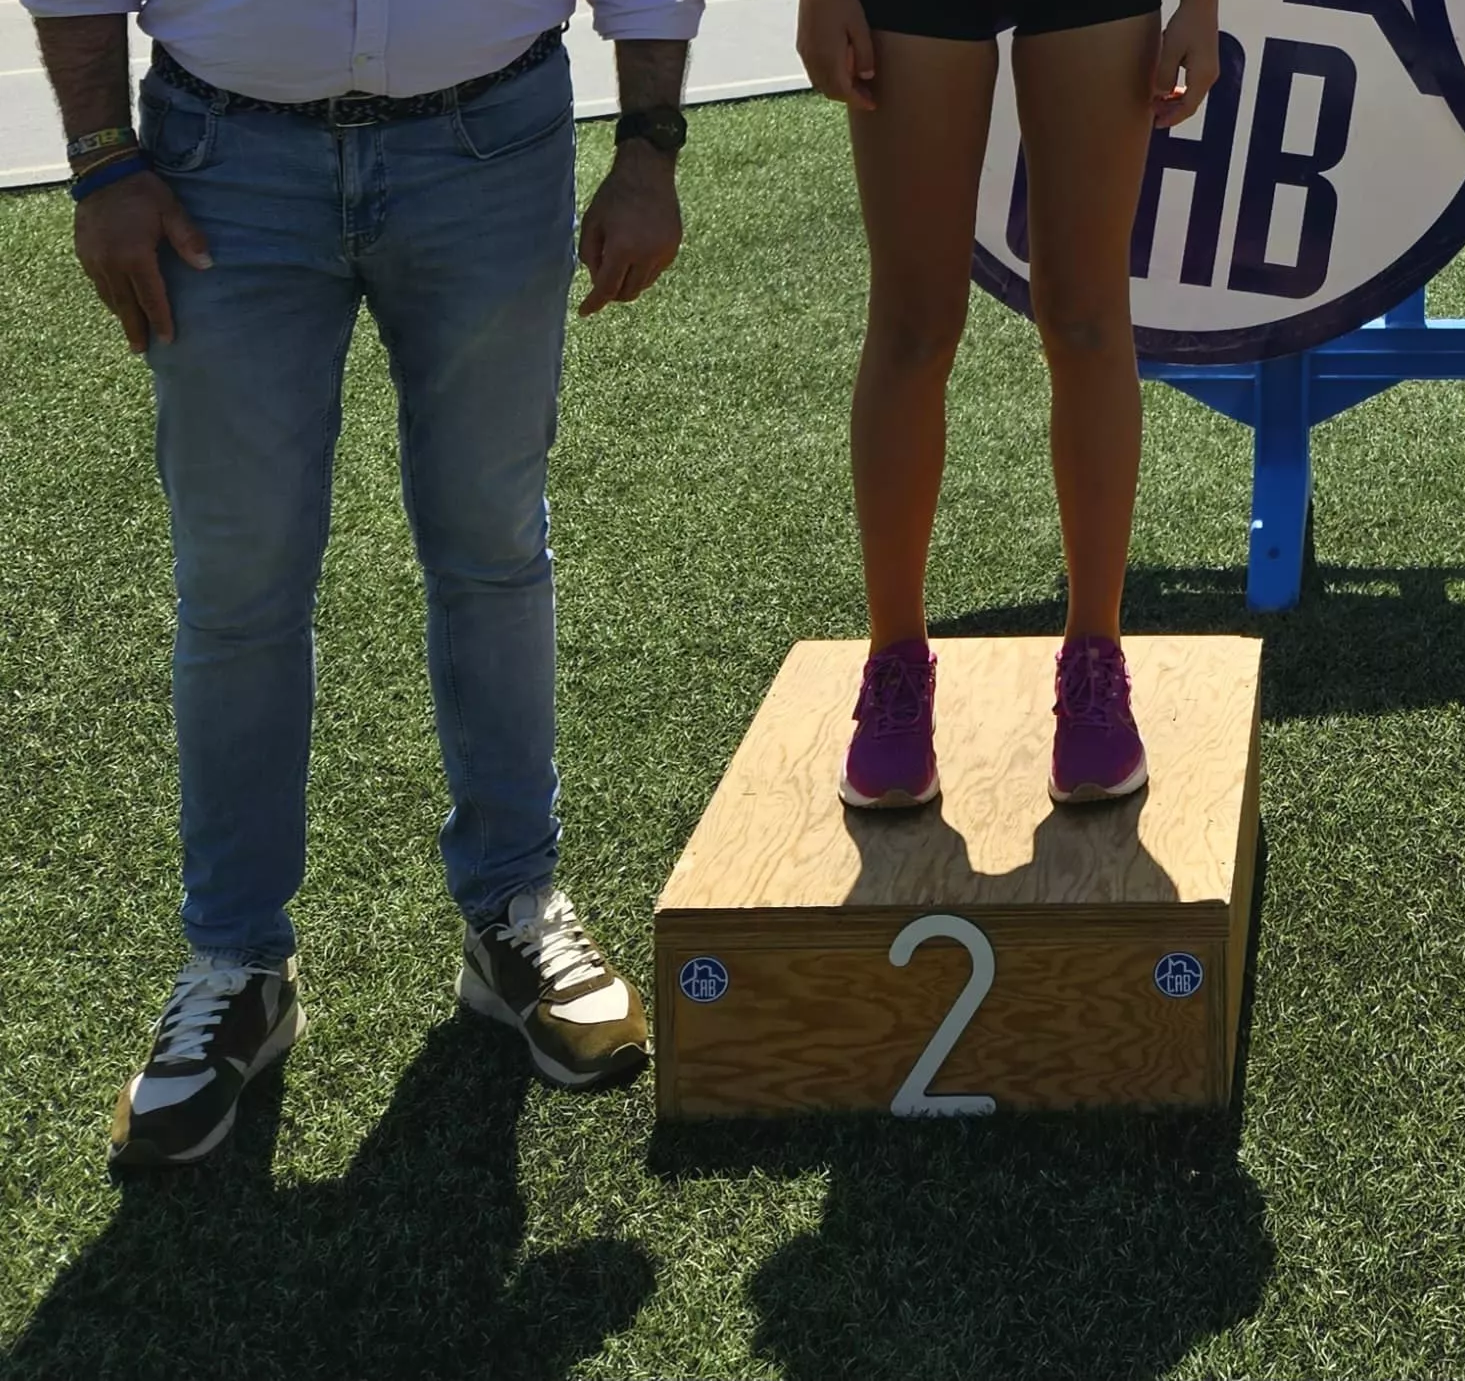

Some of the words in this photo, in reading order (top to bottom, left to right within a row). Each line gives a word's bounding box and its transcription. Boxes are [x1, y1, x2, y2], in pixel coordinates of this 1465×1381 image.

[1006, 30, 1358, 299] AB
[692, 979, 716, 998] CAB
[889, 914, 996, 1116] 2
[1167, 974, 1191, 993] CAB
